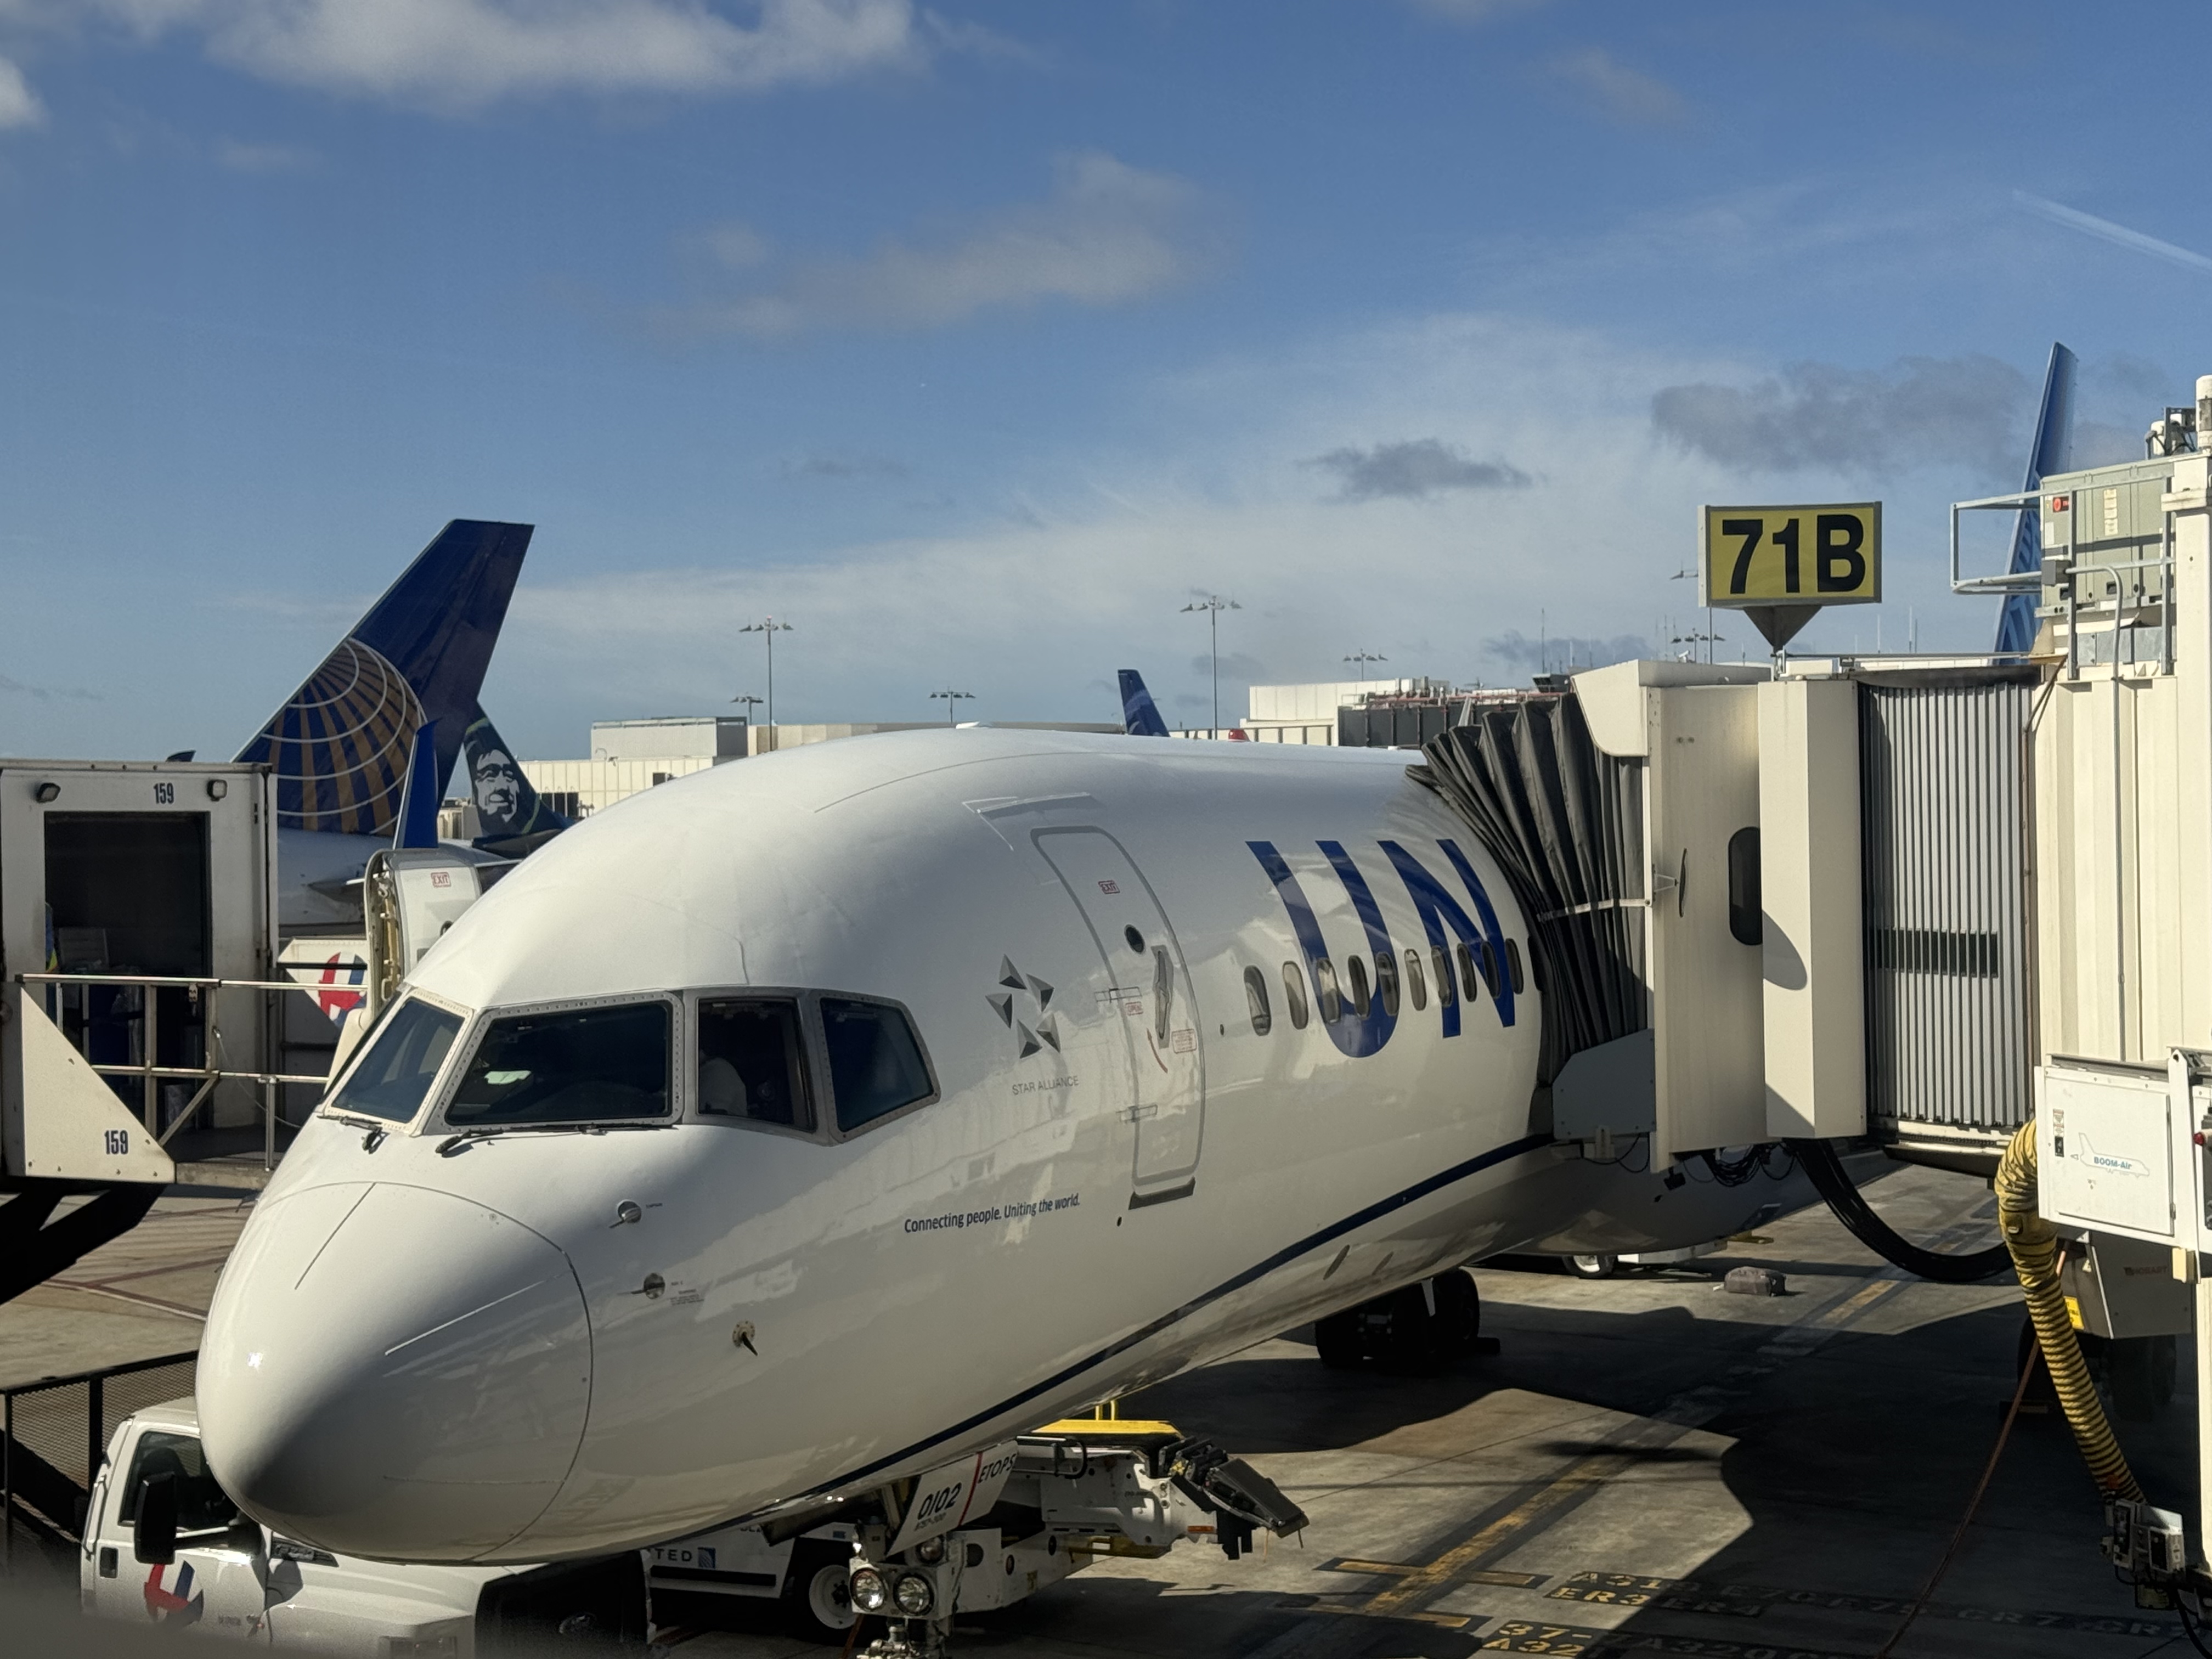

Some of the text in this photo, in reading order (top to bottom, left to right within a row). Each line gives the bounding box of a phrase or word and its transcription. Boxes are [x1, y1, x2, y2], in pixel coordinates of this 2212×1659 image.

[1722, 514, 1865, 594] 71B
[153, 782, 174, 804] 159
[1012, 1075, 1079, 1096] STAR ALLIANCE
[104, 1130, 128, 1155] 159
[904, 1193, 1080, 1233] Connecting people. Uniting the world.
[977, 1454, 1017, 1484] ETOPS
[917, 1481, 963, 1520] 0102
[654, 1548, 693, 1562] TED
[1551, 1587, 1651, 1605] ER3
